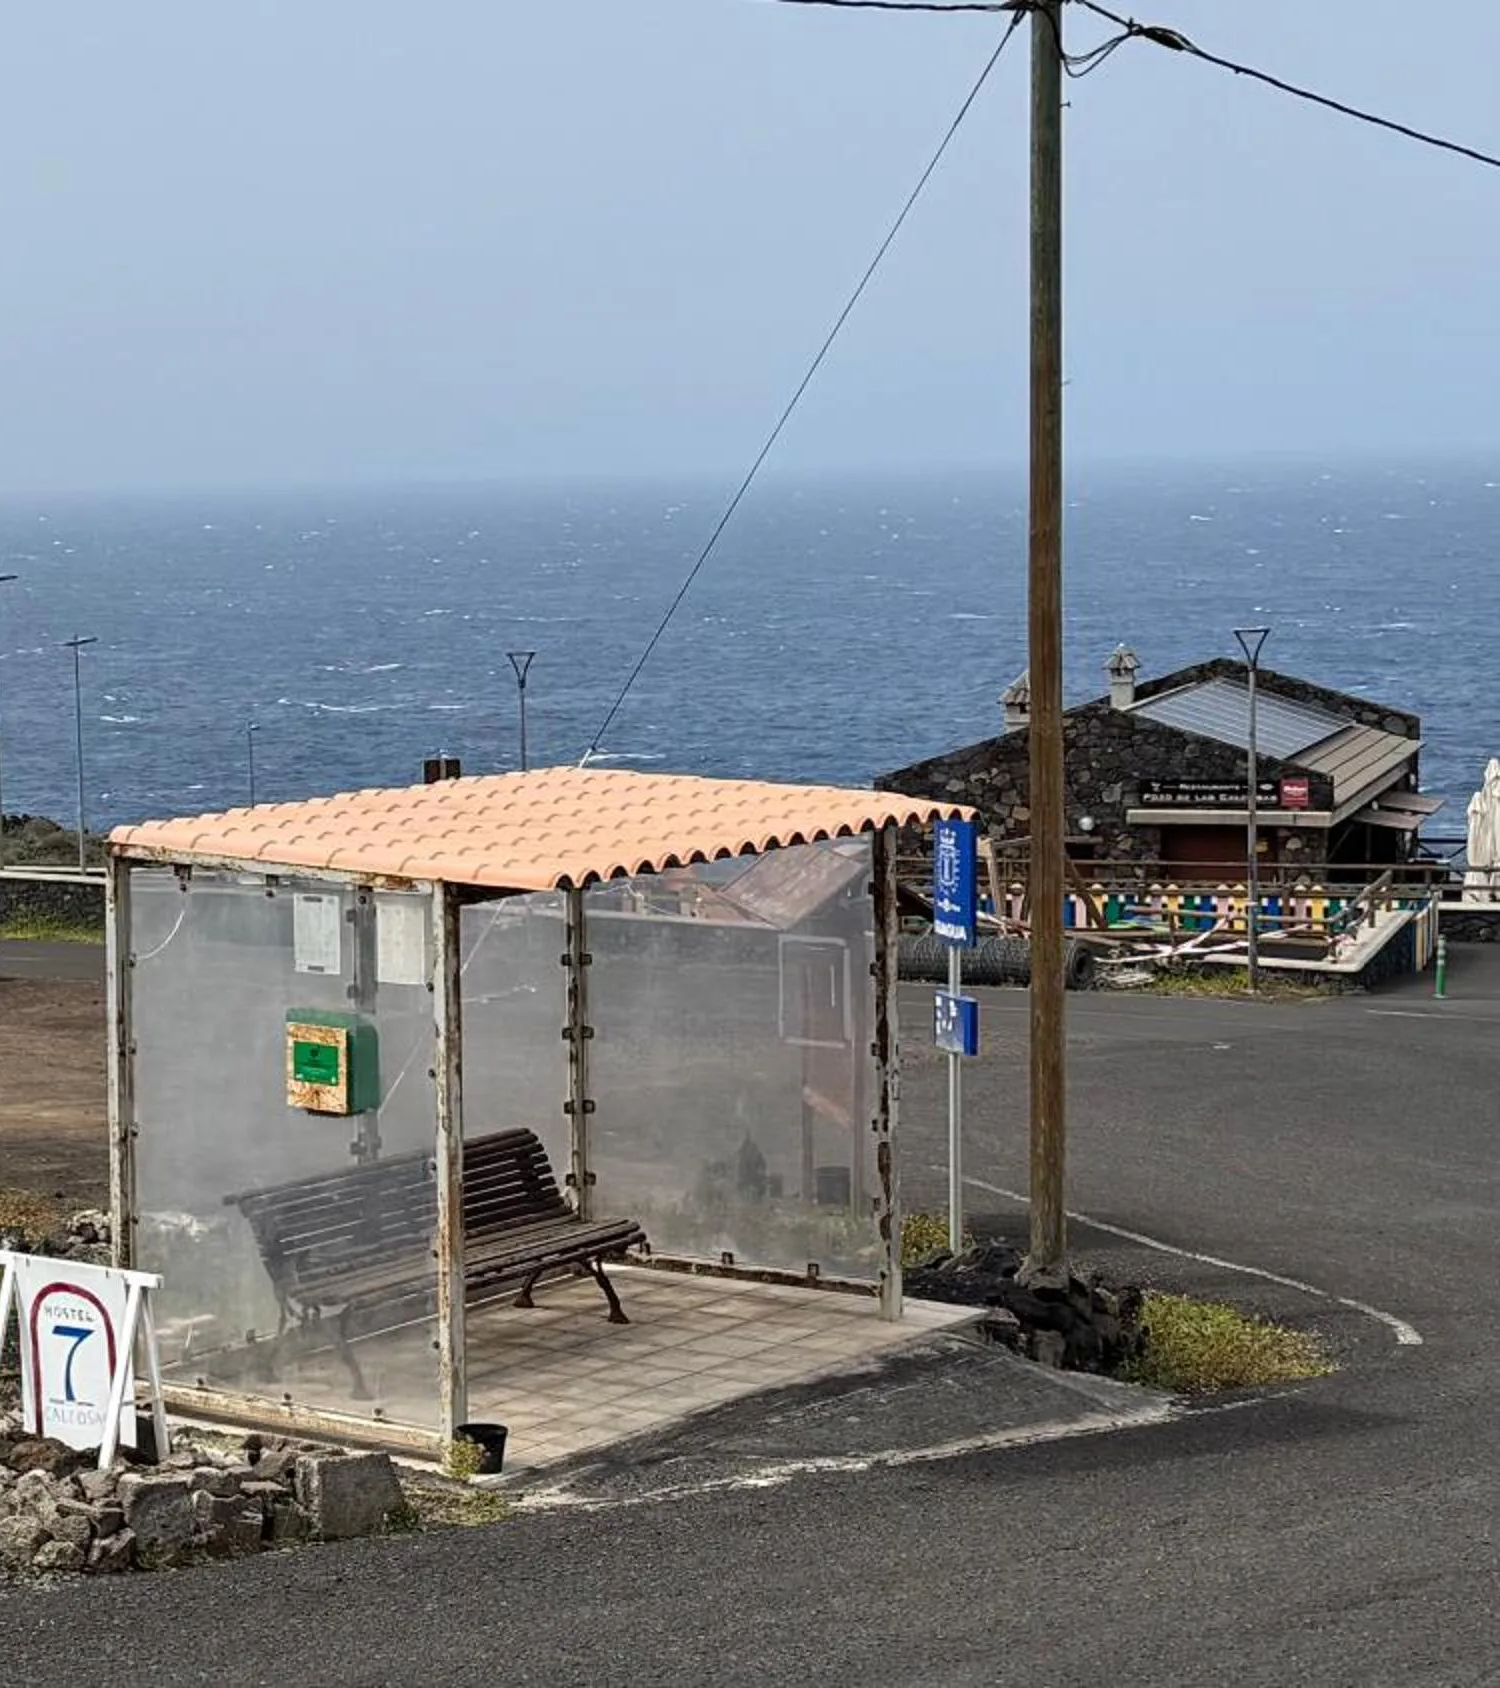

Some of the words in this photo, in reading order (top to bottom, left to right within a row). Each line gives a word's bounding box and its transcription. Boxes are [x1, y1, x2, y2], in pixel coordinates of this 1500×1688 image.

[44, 1306, 93, 1322] HOSTEL
[52, 1326, 95, 1402] 7
[46, 1407, 106, 1425] CALCOSA
